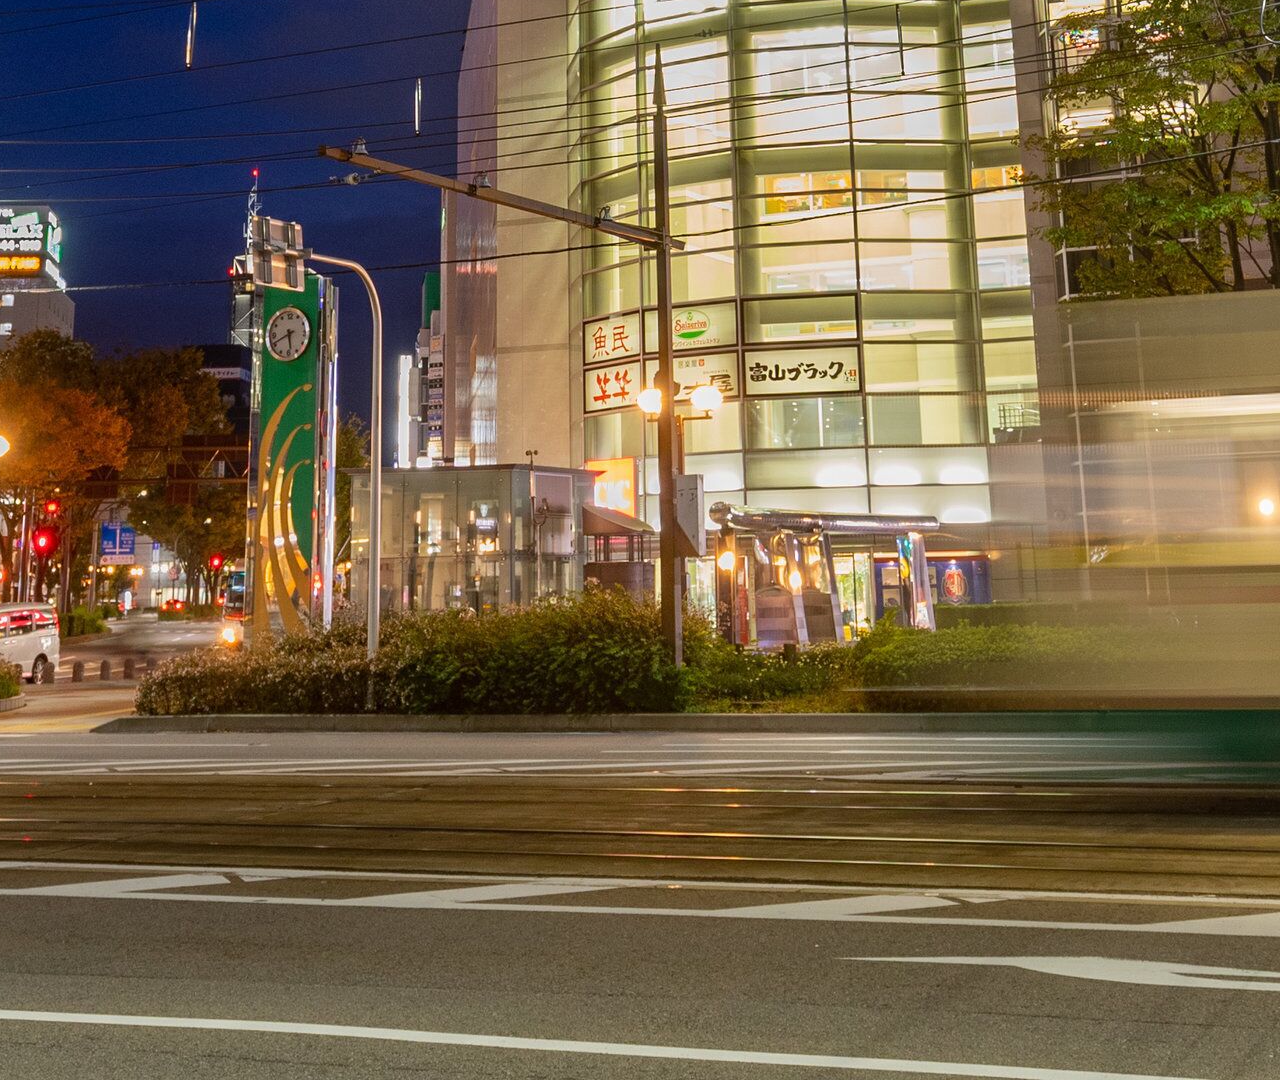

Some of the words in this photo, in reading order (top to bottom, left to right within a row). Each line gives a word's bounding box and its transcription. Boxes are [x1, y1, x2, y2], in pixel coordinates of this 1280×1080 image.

[592, 325, 629, 359] 魚民
[593, 369, 632, 404] 笑笑
[749, 362, 844, 382] 富山ブラック
